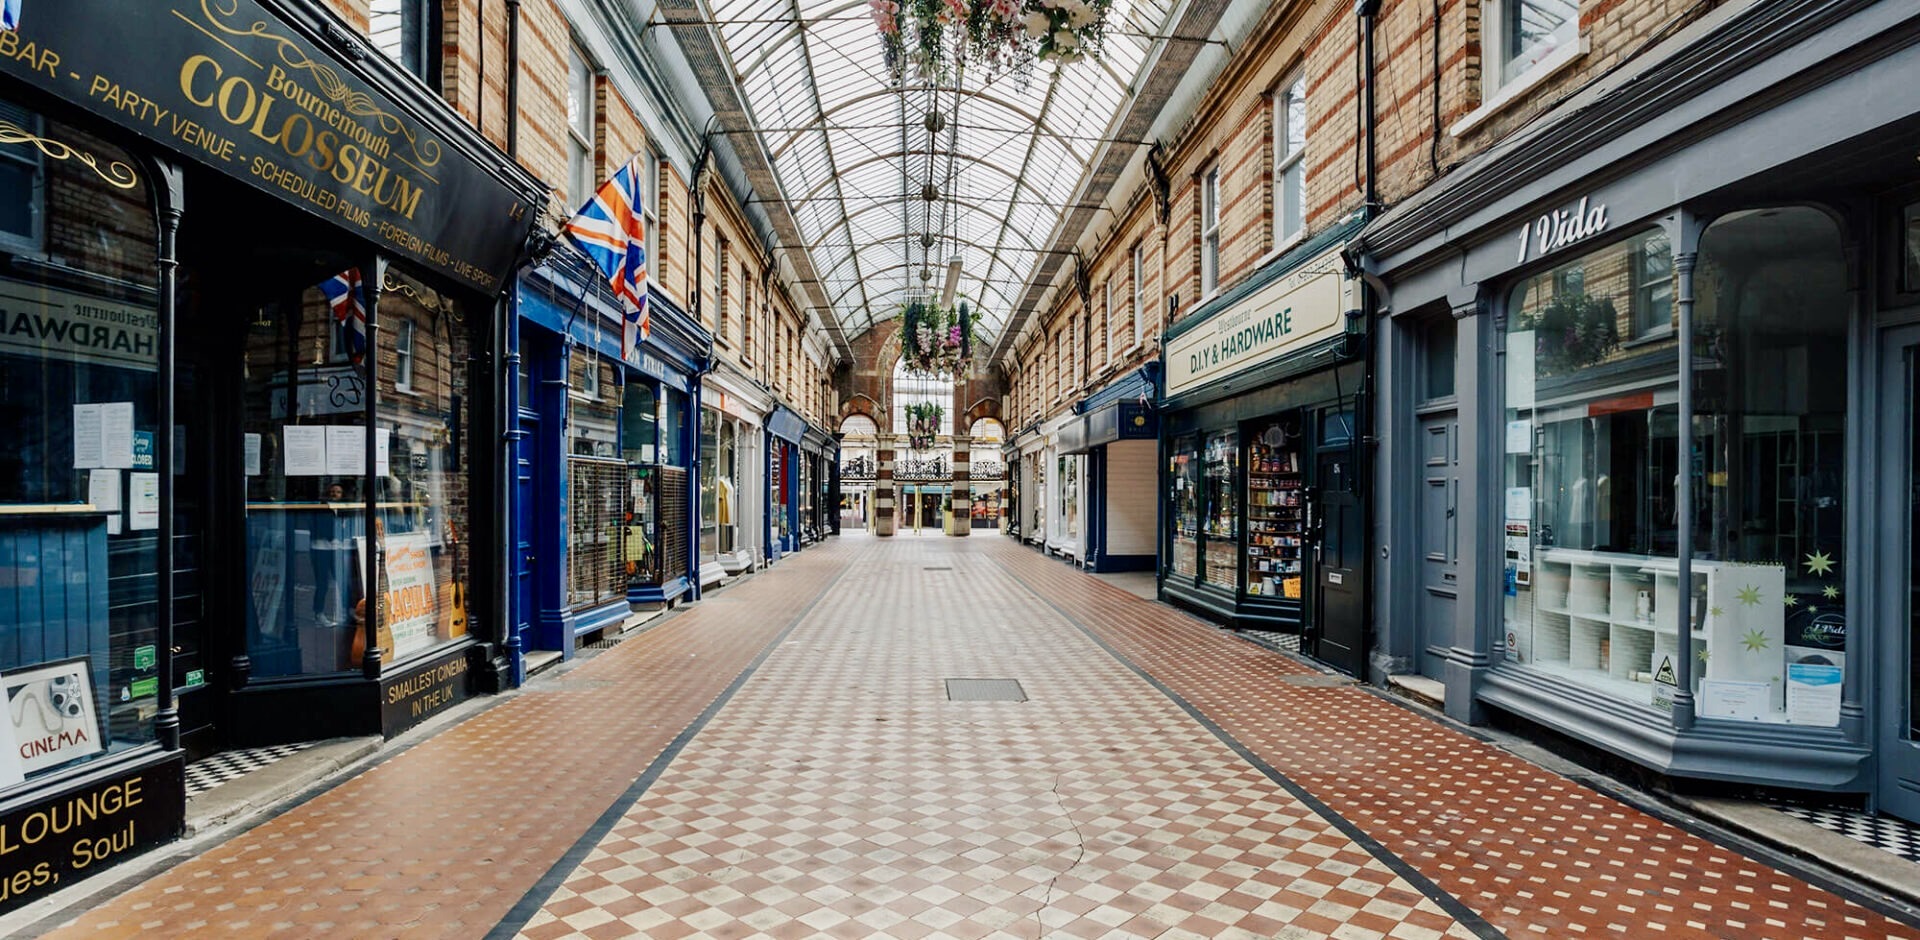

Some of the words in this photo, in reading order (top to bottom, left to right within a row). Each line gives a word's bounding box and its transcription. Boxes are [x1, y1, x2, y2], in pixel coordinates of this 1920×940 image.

[180, 54, 423, 221] COLOSSEUM
[266, 64, 390, 160] Bournemouth
[0, 29, 60, 78] BAR
[89, 75, 168, 127] PARTY
[172, 113, 236, 162] VENUE
[251, 156, 337, 210] SCHEDULED
[336, 200, 371, 228] FILMS
[378, 221, 423, 254] FOREIGN
[423, 243, 450, 266] FILMS
[454, 260, 473, 277] LIVE
[1518, 222, 1530, 263] 1
[1537, 195, 1607, 254] Vida
[1212, 343, 1219, 365] &
[1221, 307, 1292, 361] HARDWARE
[388, 669, 437, 704] SMALLEST
[437, 657, 468, 682] CINEMA
[412, 700, 422, 718] IN
[423, 689, 440, 711] THE
[441, 683, 454, 702] UK
[20, 728, 88, 759] CINEMA
[0, 776, 143, 855] LOUNGE
[72, 820, 134, 869] Soul
